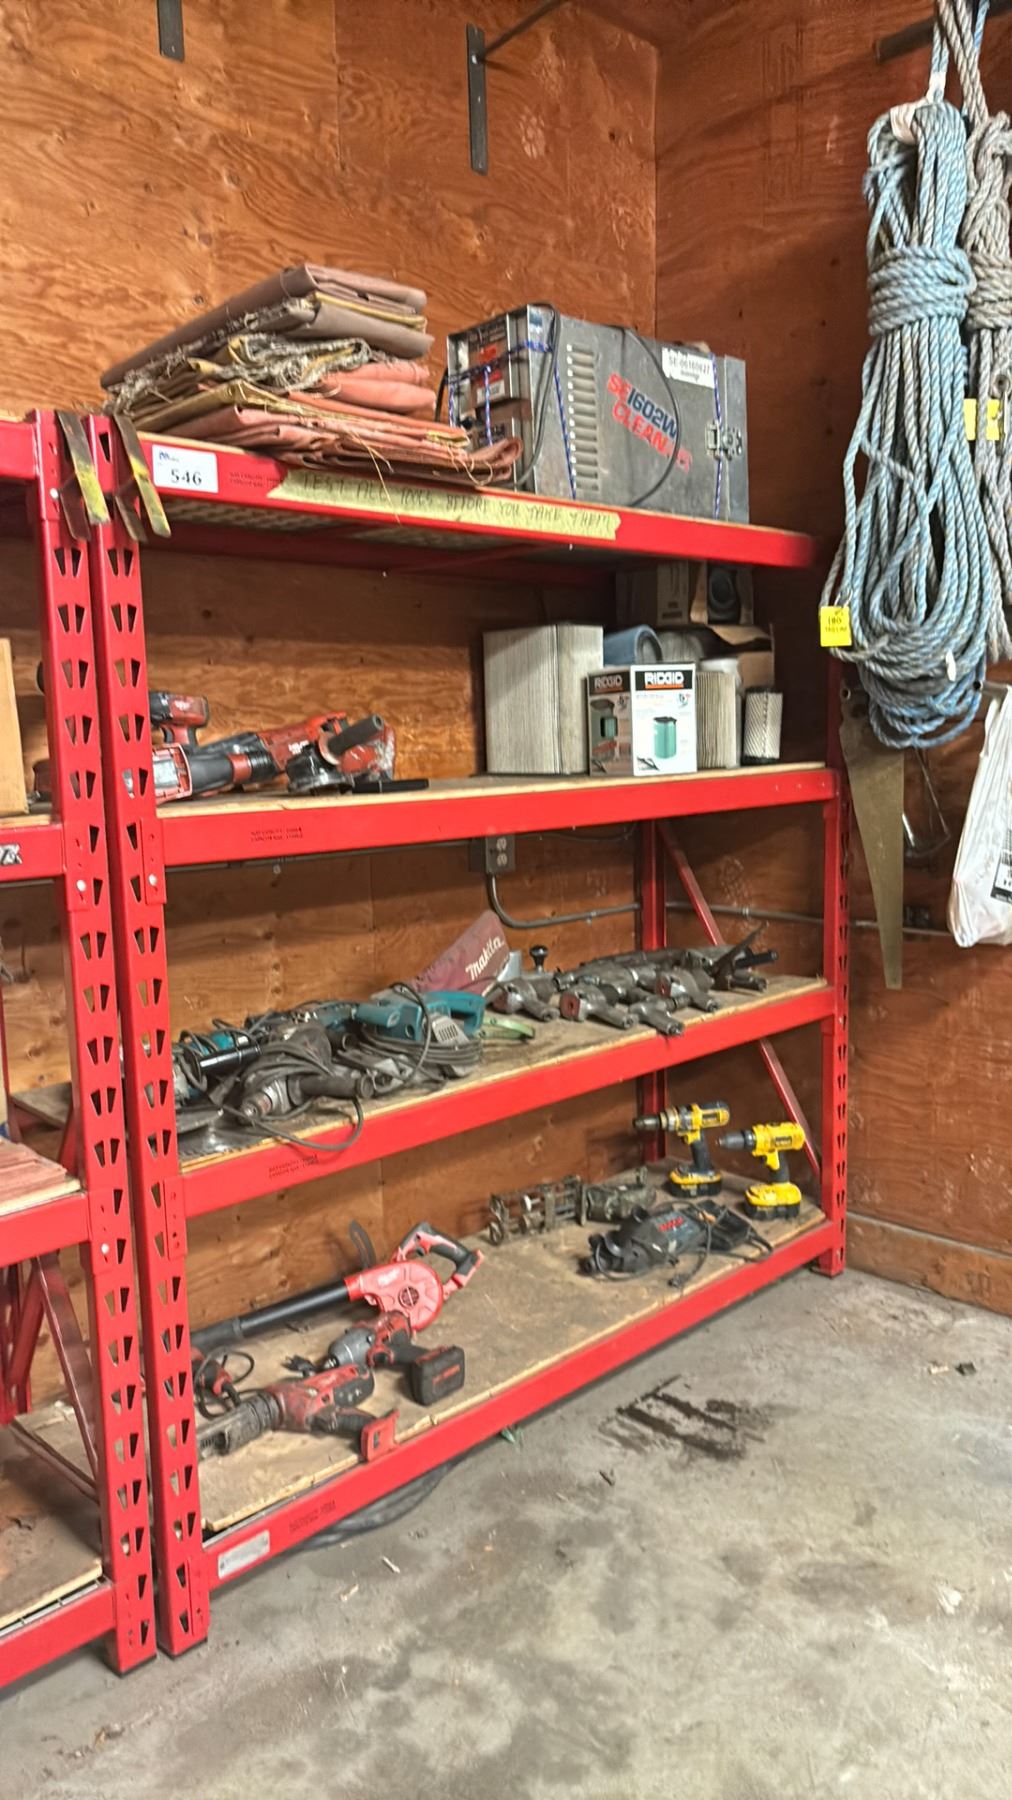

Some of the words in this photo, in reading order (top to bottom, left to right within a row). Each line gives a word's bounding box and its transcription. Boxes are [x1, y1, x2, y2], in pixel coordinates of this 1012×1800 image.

[171, 469, 202, 486] 546
[302, 473, 346, 494] TEST
[499, 501, 520, 517] YOU
[594, 675, 623, 689] RIDGID
[644, 671, 685, 686] RIDGID
